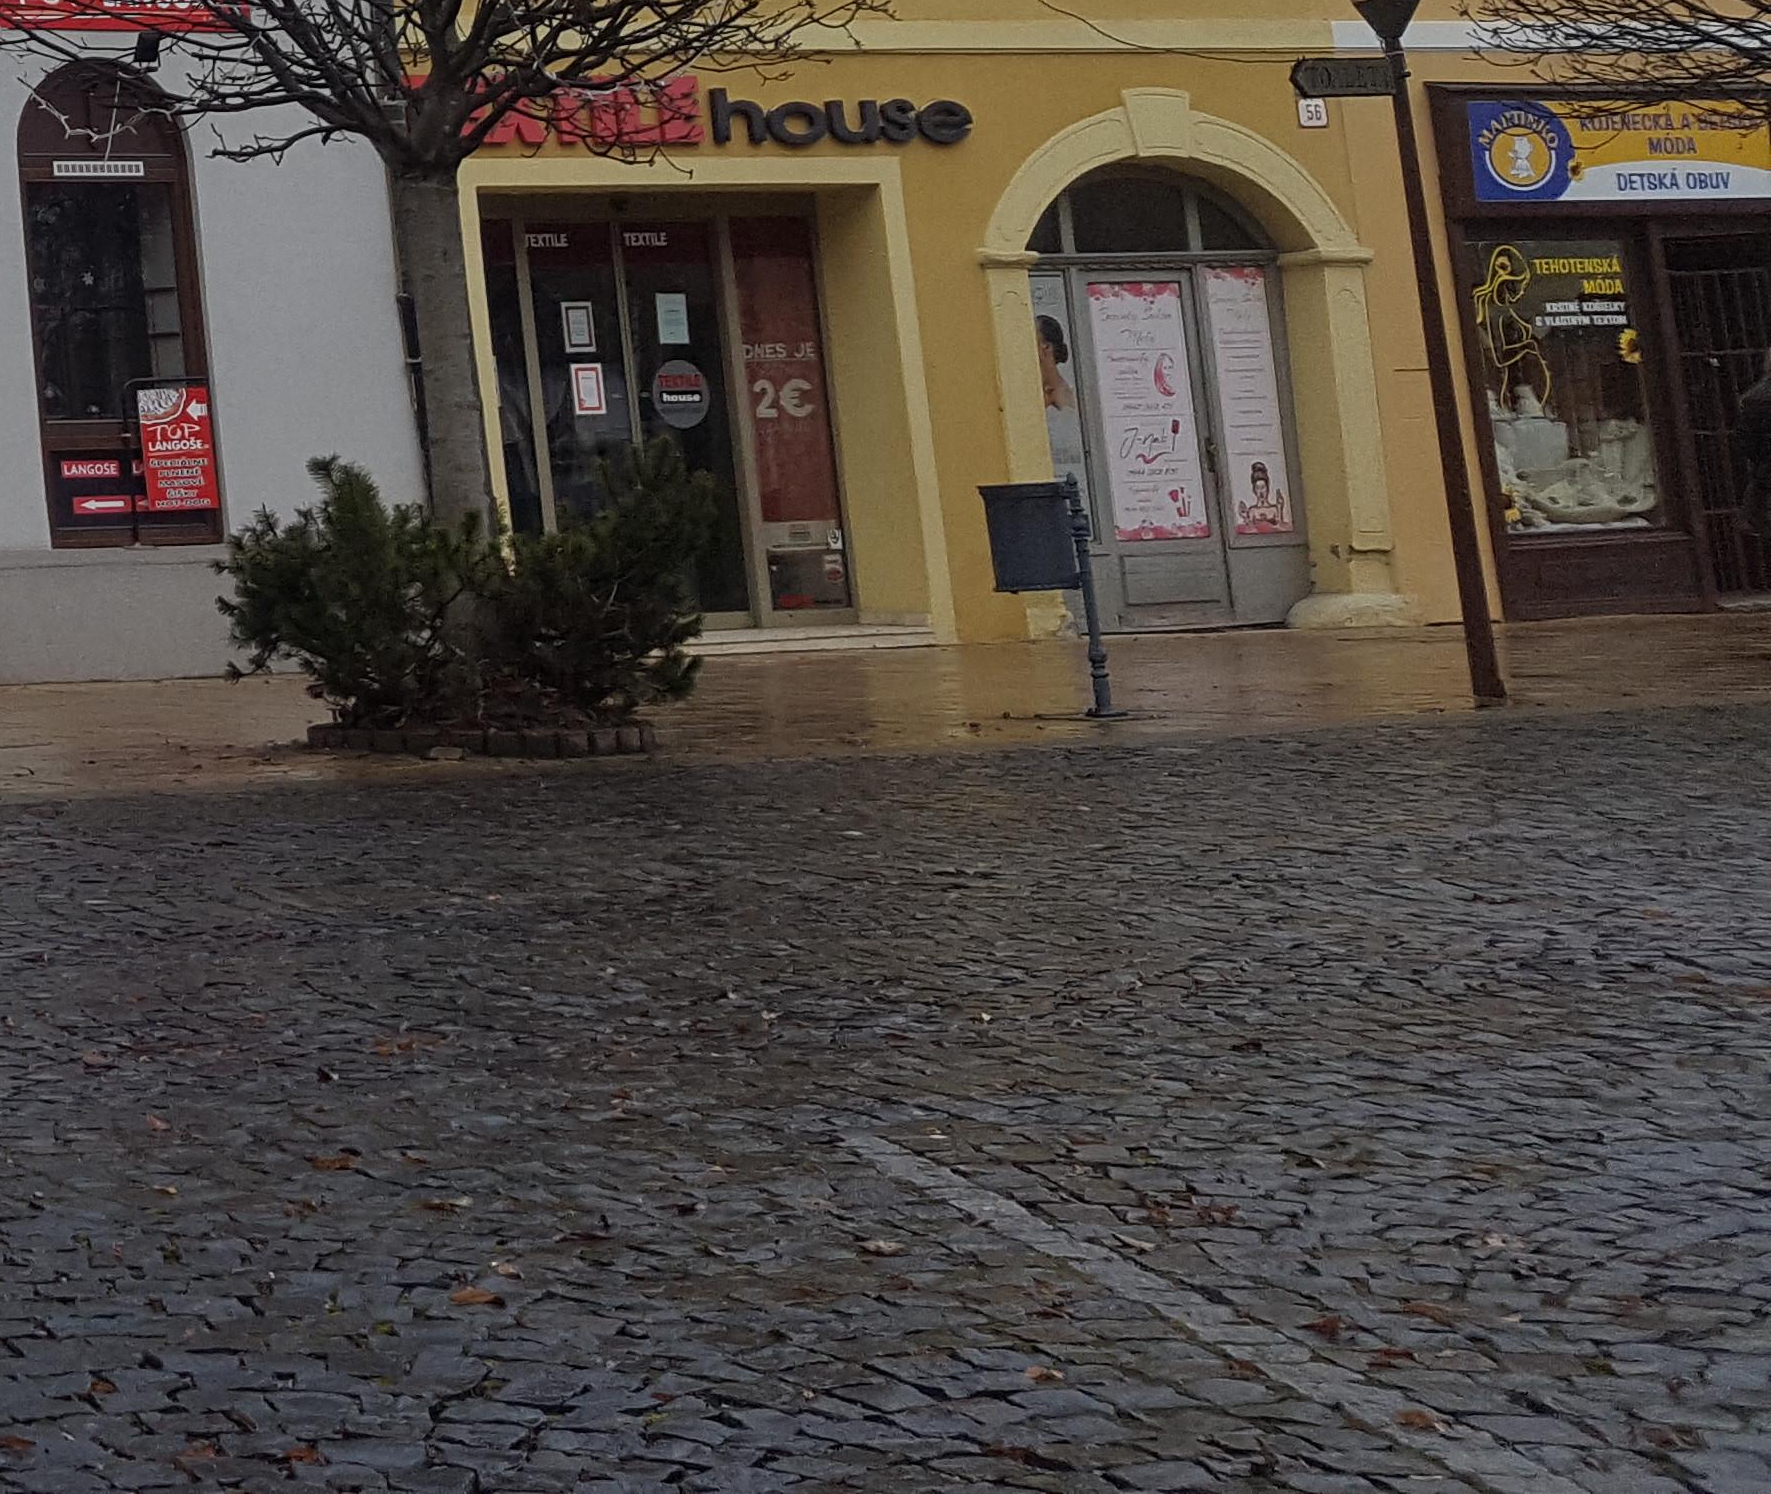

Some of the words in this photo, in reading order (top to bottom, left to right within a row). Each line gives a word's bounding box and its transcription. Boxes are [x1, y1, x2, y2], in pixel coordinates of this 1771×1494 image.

[708, 86, 973, 146] house
[1305, 104, 1323, 122] 56
[1477, 109, 1560, 151] MARTINKO
[1648, 132, 1697, 155] MÓDA
[1616, 167, 1680, 191] DETSKÁ
[1688, 171, 1731, 190] OBUV
[622, 231, 669, 247] TEXTILE
[1531, 254, 1622, 275] TEHOTENSKÁ
[1582, 275, 1625, 295] MÓDA
[661, 391, 701, 403] house
[753, 378, 814, 419] 2€
[146, 424, 202, 441] TOP
[147, 437, 203, 452] LANGOŠE
[62, 461, 120, 477] LANGOŠE
